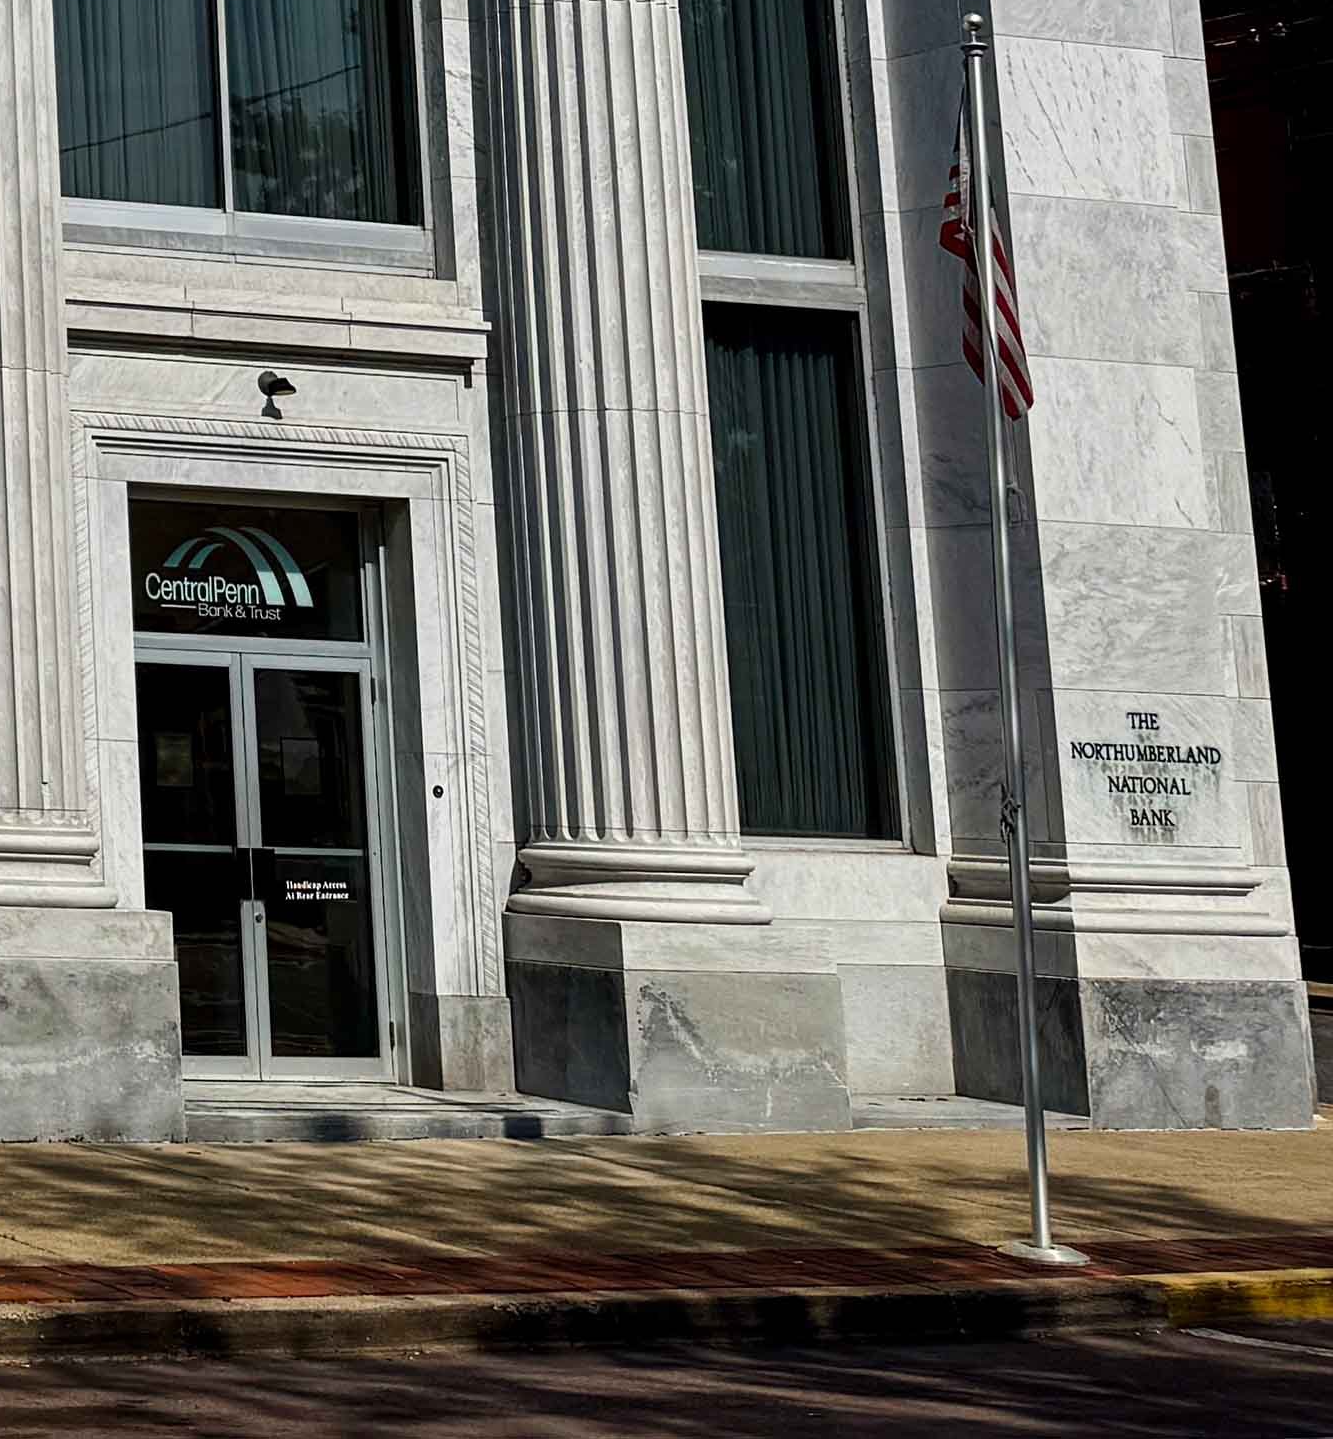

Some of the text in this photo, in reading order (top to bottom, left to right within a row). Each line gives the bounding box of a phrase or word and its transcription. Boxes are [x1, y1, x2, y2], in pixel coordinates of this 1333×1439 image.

[145, 572, 260, 605] CentralPenn
[198, 602, 282, 620] Bank & Trust
[1126, 712, 1160, 730] THE
[1070, 741, 1222, 764] NORTHUMBERLAND
[1108, 776, 1191, 795] NATIONAL
[1130, 808, 1175, 826] BANK
